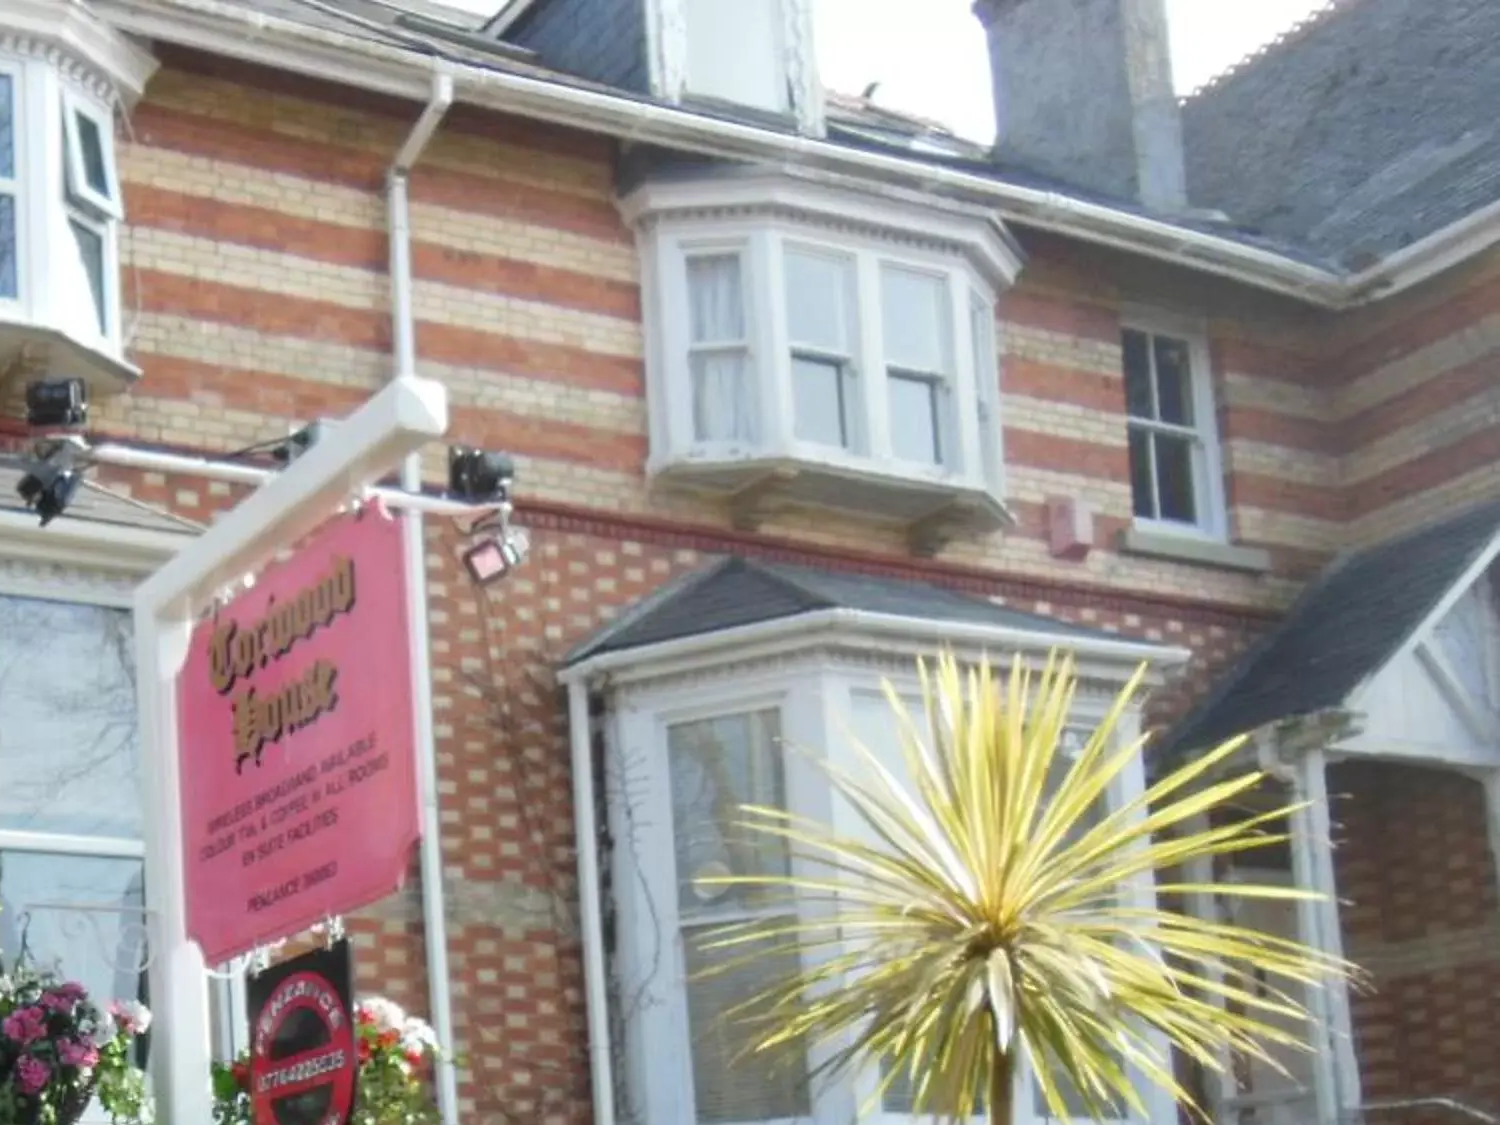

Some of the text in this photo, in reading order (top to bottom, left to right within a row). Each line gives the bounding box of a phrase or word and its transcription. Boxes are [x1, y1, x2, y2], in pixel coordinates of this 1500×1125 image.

[320, 732, 378, 773] AVAILABLE
[269, 795, 308, 825] COFFEE
[325, 779, 346, 796] ALL
[348, 752, 390, 784] ROOMS
[287, 807, 340, 844] FACILITIES
